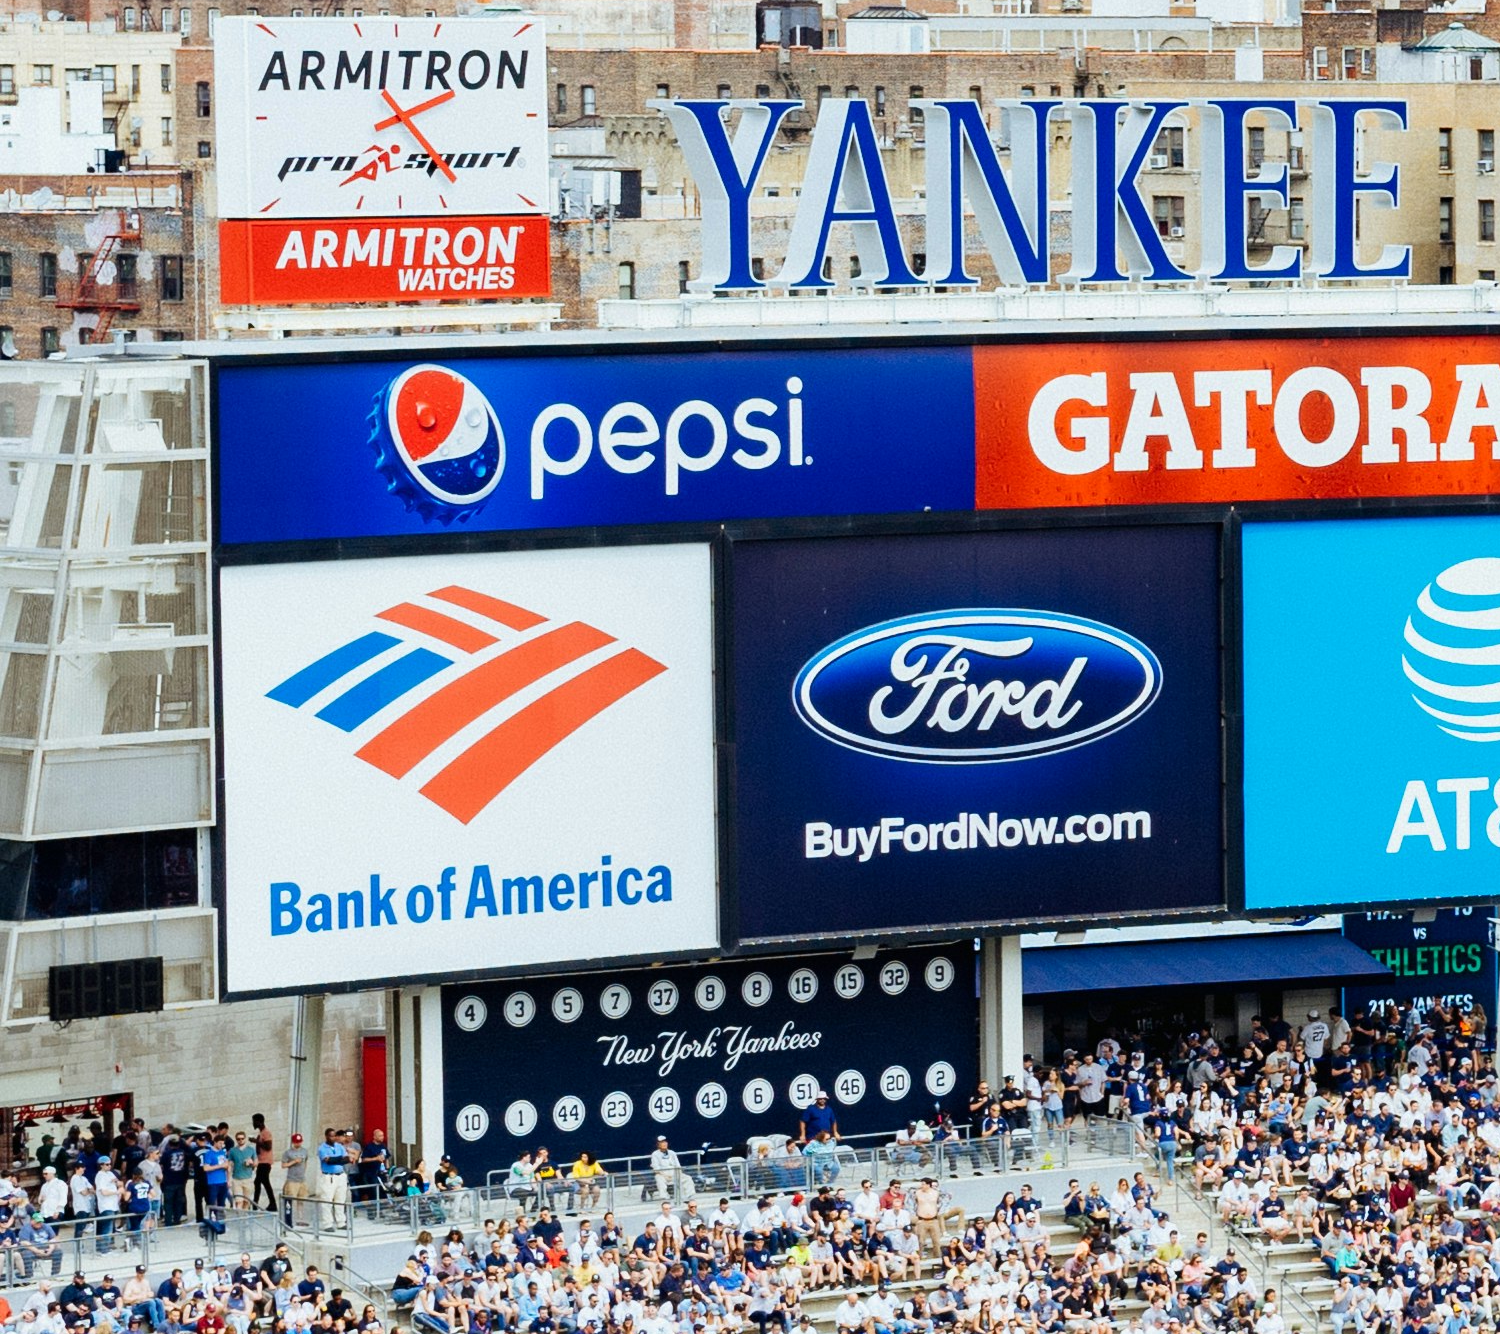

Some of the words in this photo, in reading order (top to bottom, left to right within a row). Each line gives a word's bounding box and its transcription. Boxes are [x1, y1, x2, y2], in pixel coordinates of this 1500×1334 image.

[258, 49, 528, 91] ARMITRON
[650, 95, 1412, 293] YANKEE
[275, 226, 518, 269] ARMITRON
[398, 267, 515, 291] WATCHES
[529, 377, 804, 499] pepsi
[870, 636, 1087, 736] Ford
[803, 809, 1151, 863] BuyFordNow.com
[269, 878, 398, 936] Bank
[405, 865, 459, 921] of
[466, 856, 673, 919] America
[596, 1035, 655, 1066] New
[657, 1026, 725, 1077] York
[724, 1022, 821, 1072] Yankees
